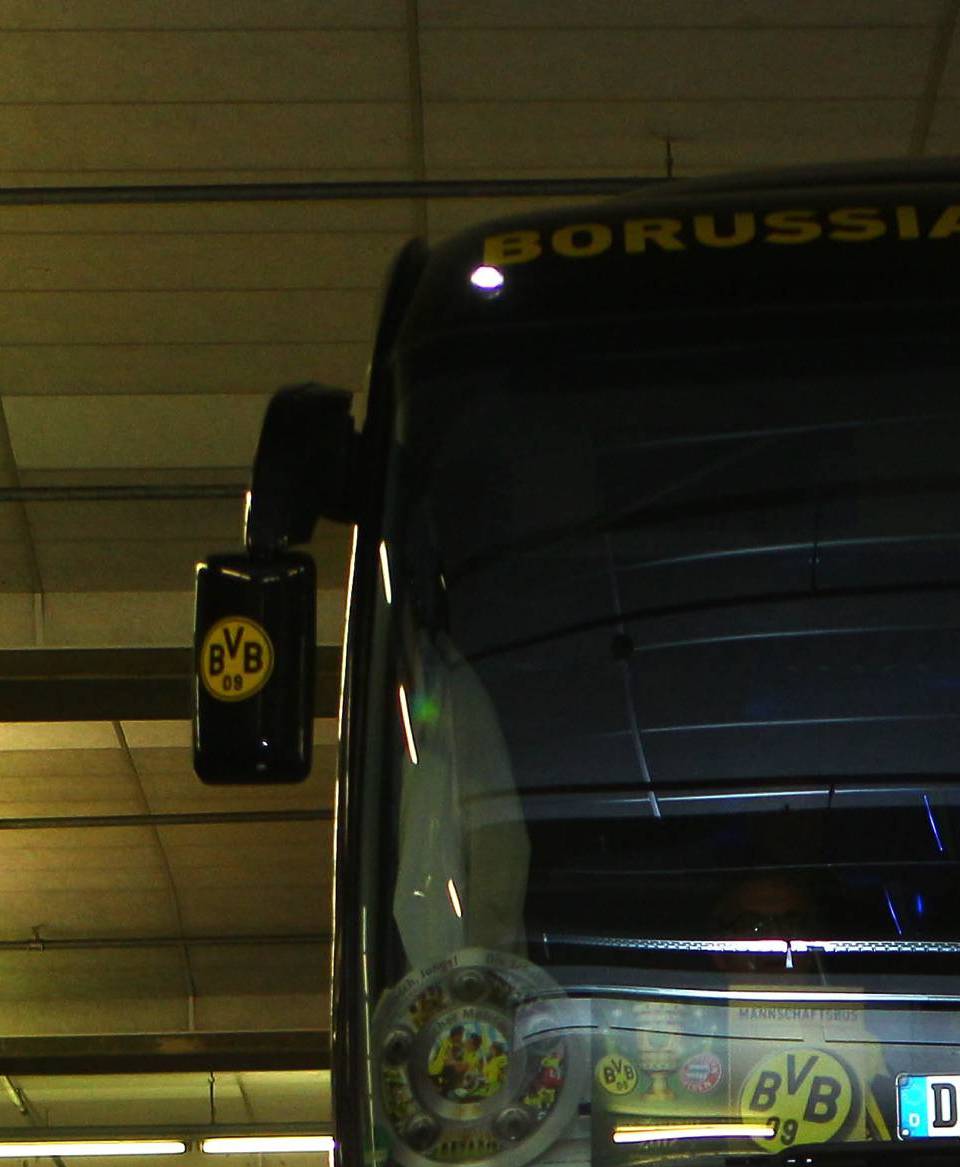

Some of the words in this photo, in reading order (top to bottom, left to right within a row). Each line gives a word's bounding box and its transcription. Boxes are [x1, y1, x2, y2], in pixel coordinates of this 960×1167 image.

[208, 626, 264, 676] BVB
[222, 673, 244, 691] 09
[603, 1057, 635, 1086] BVB
[749, 1053, 843, 1123] BVB
